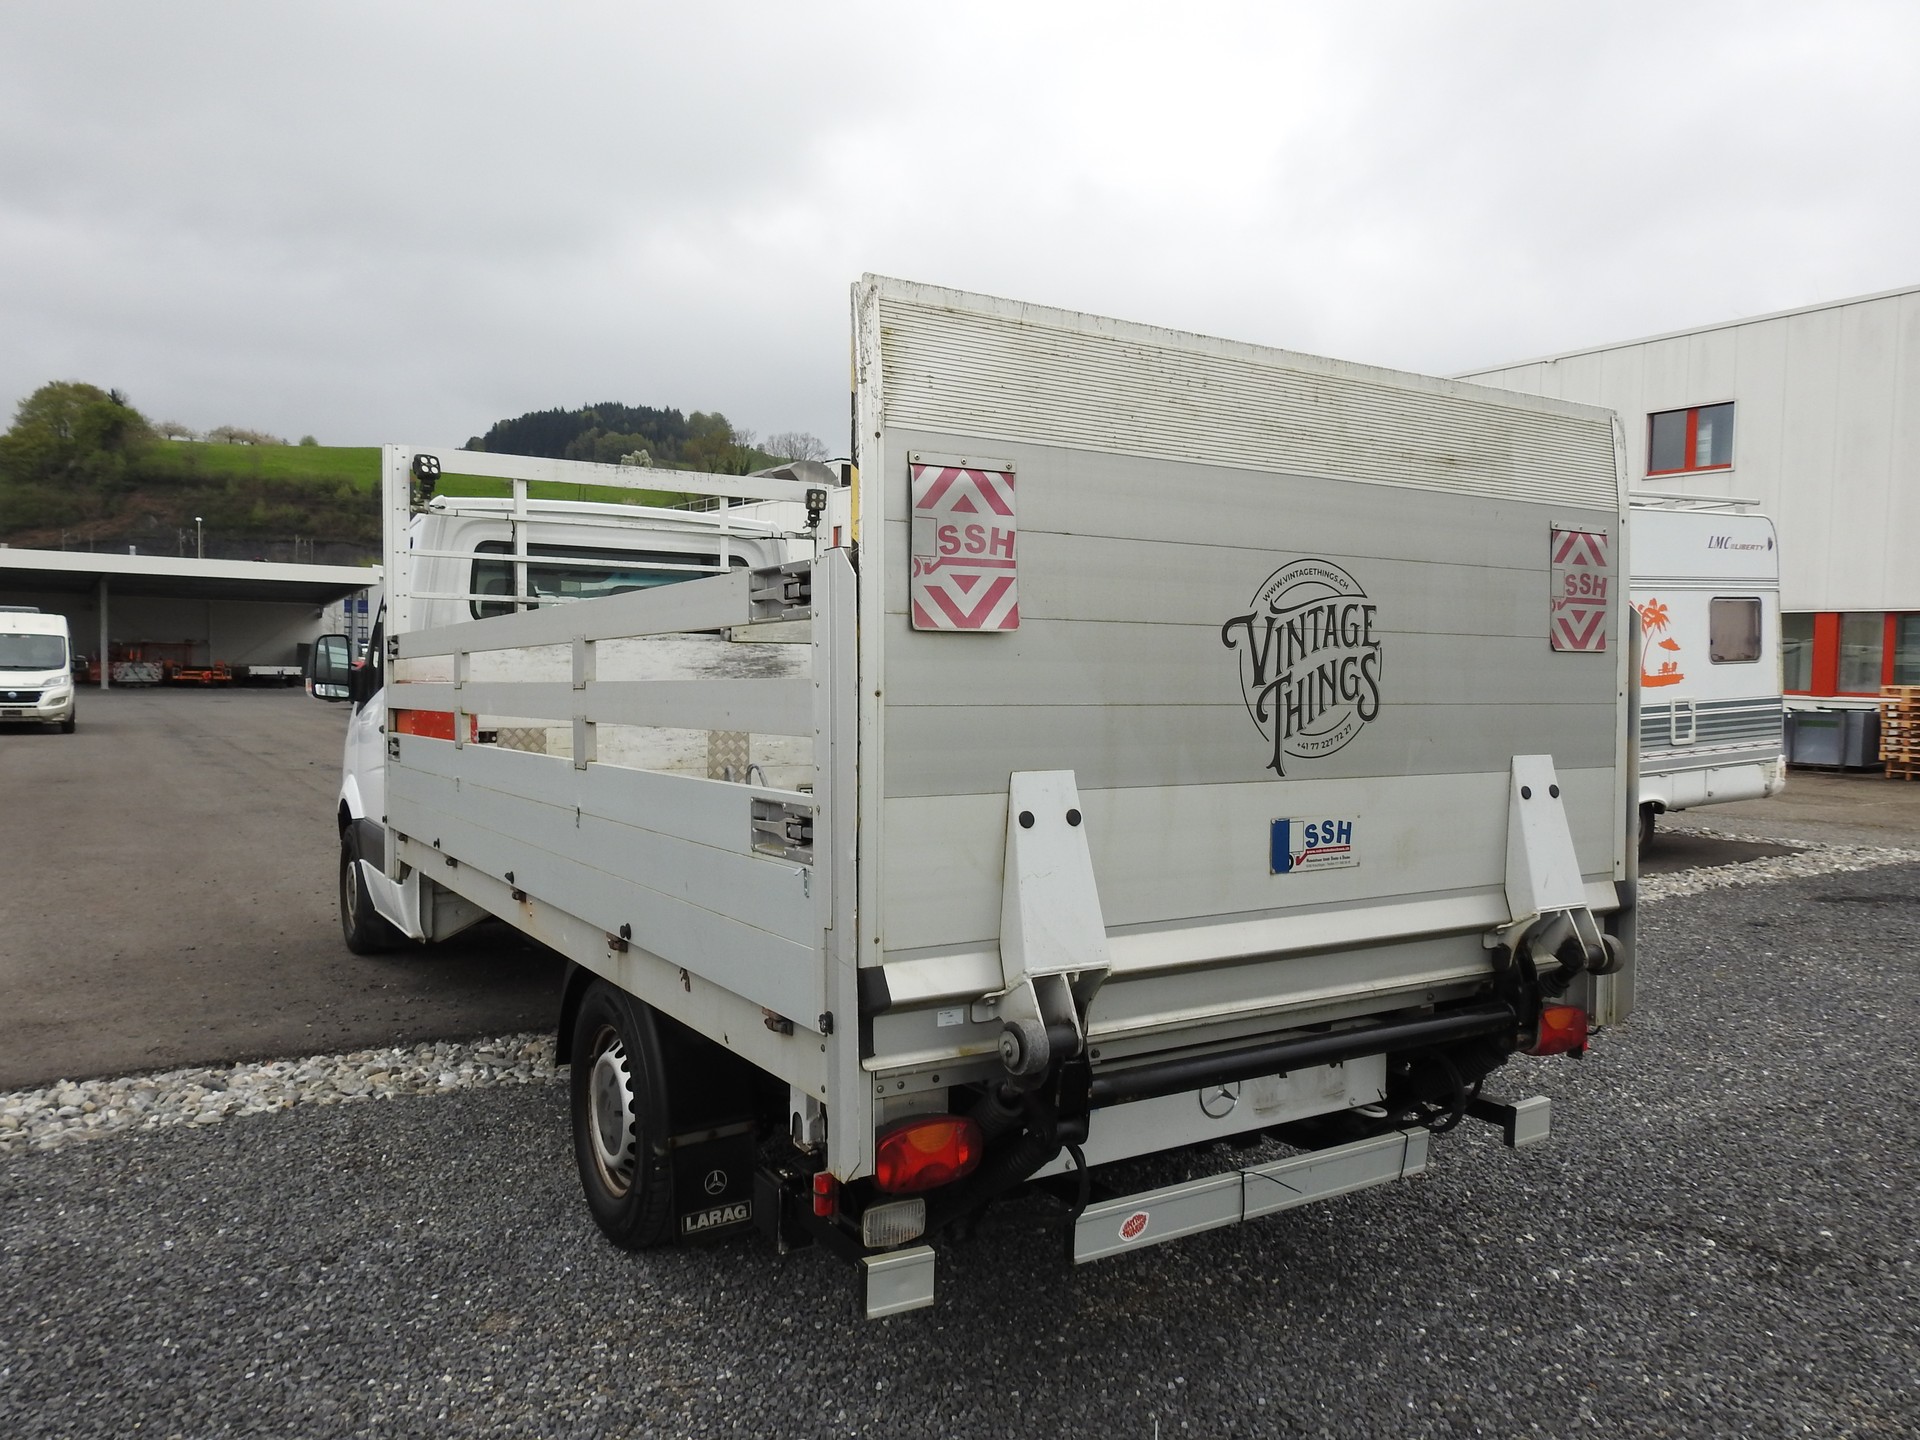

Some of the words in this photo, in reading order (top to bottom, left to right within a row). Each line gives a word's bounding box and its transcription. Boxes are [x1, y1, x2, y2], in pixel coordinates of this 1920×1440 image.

[938, 524, 1016, 559] SSH
[1708, 536, 1732, 550] LMC
[1735, 543, 1764, 551] LIBERTY
[1263, 568, 1349, 602] WWW.VINTAGETHINGS.CH
[1566, 573, 1608, 598] SSH
[1221, 603, 1380, 689] VINTAGE
[1256, 652, 1380, 778] THINGS
[1297, 742, 1309, 750] +41
[1310, 742, 1319, 750] 77
[1321, 738, 1333, 748] 227
[1334, 732, 1343, 741] 72
[1343, 723, 1351, 735] 27
[1304, 820, 1352, 848] SSH
[686, 1205, 747, 1231] LARAG
